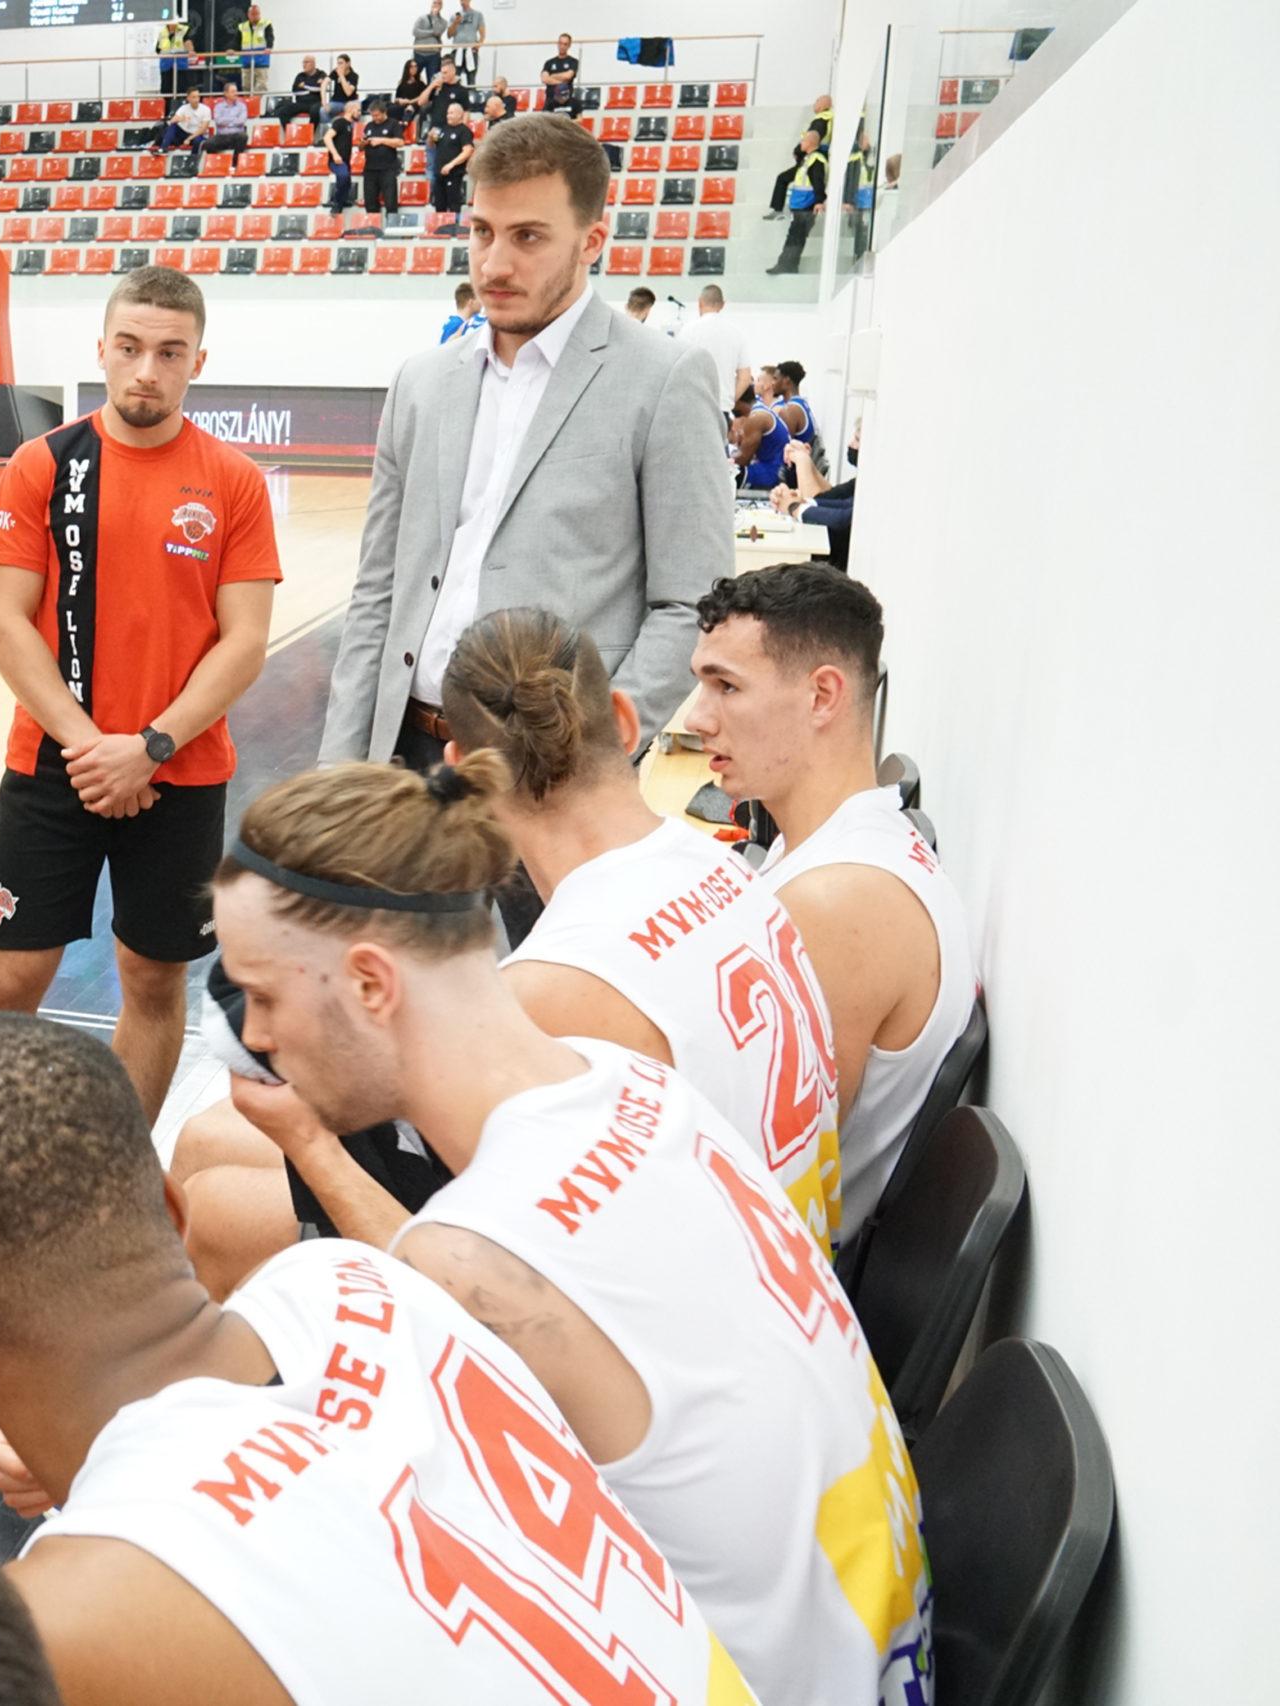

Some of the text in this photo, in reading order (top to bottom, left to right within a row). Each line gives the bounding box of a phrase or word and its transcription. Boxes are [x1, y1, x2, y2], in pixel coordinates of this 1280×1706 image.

[65, 524, 83, 596] OSE
[716, 906, 838, 1172] 20
[536, 1126, 647, 1236] MVM
[379, 1333, 684, 1706] 14
